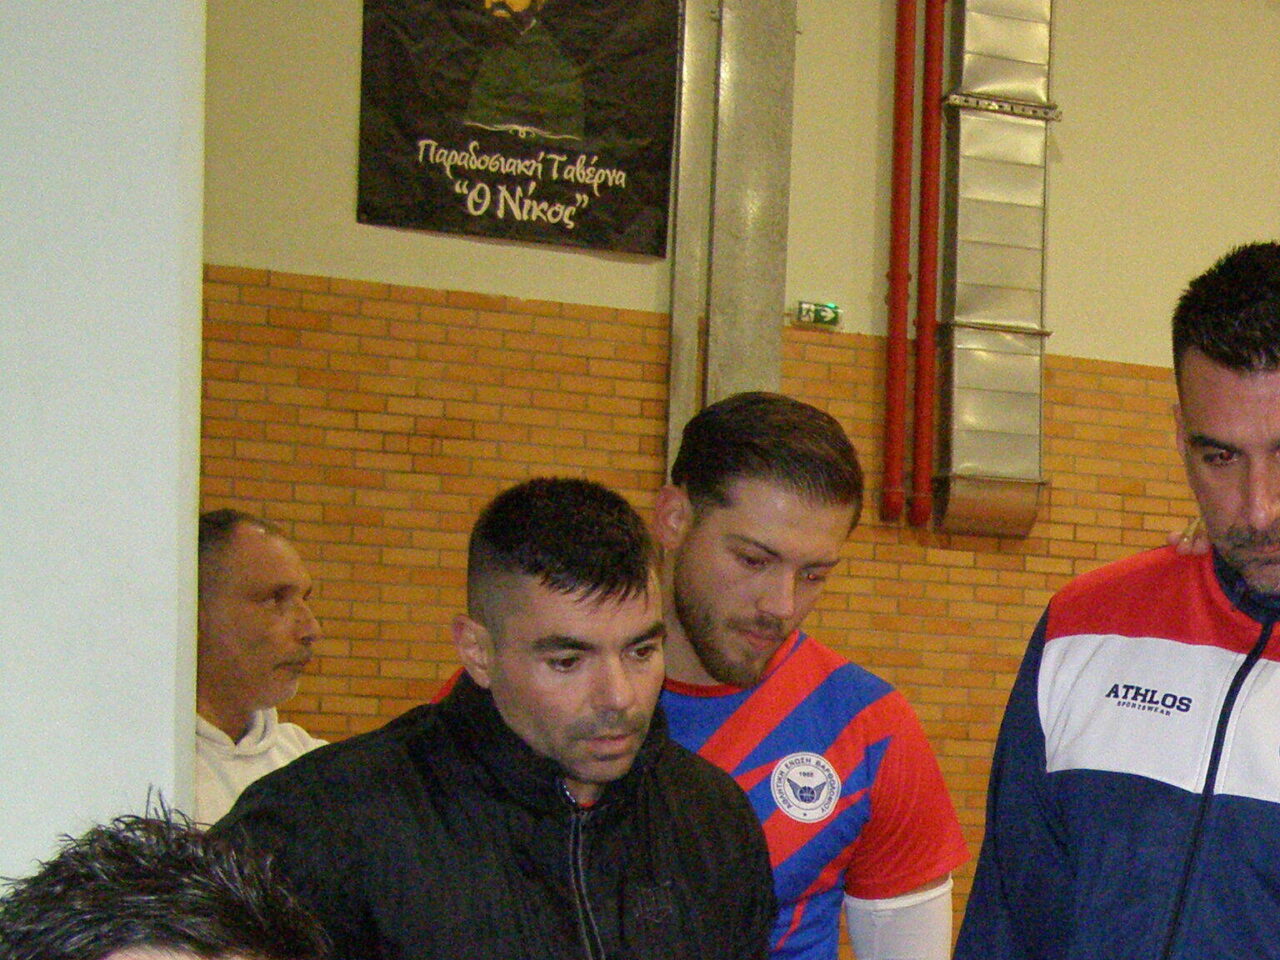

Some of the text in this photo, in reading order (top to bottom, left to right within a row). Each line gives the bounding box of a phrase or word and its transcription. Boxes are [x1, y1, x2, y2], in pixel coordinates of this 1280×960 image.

[418, 139, 627, 197] Παραδοσιακή Ταβέρνα
[1105, 683, 1193, 714] ATHLOS
[1116, 700, 1171, 717] SPORTSWEAR
